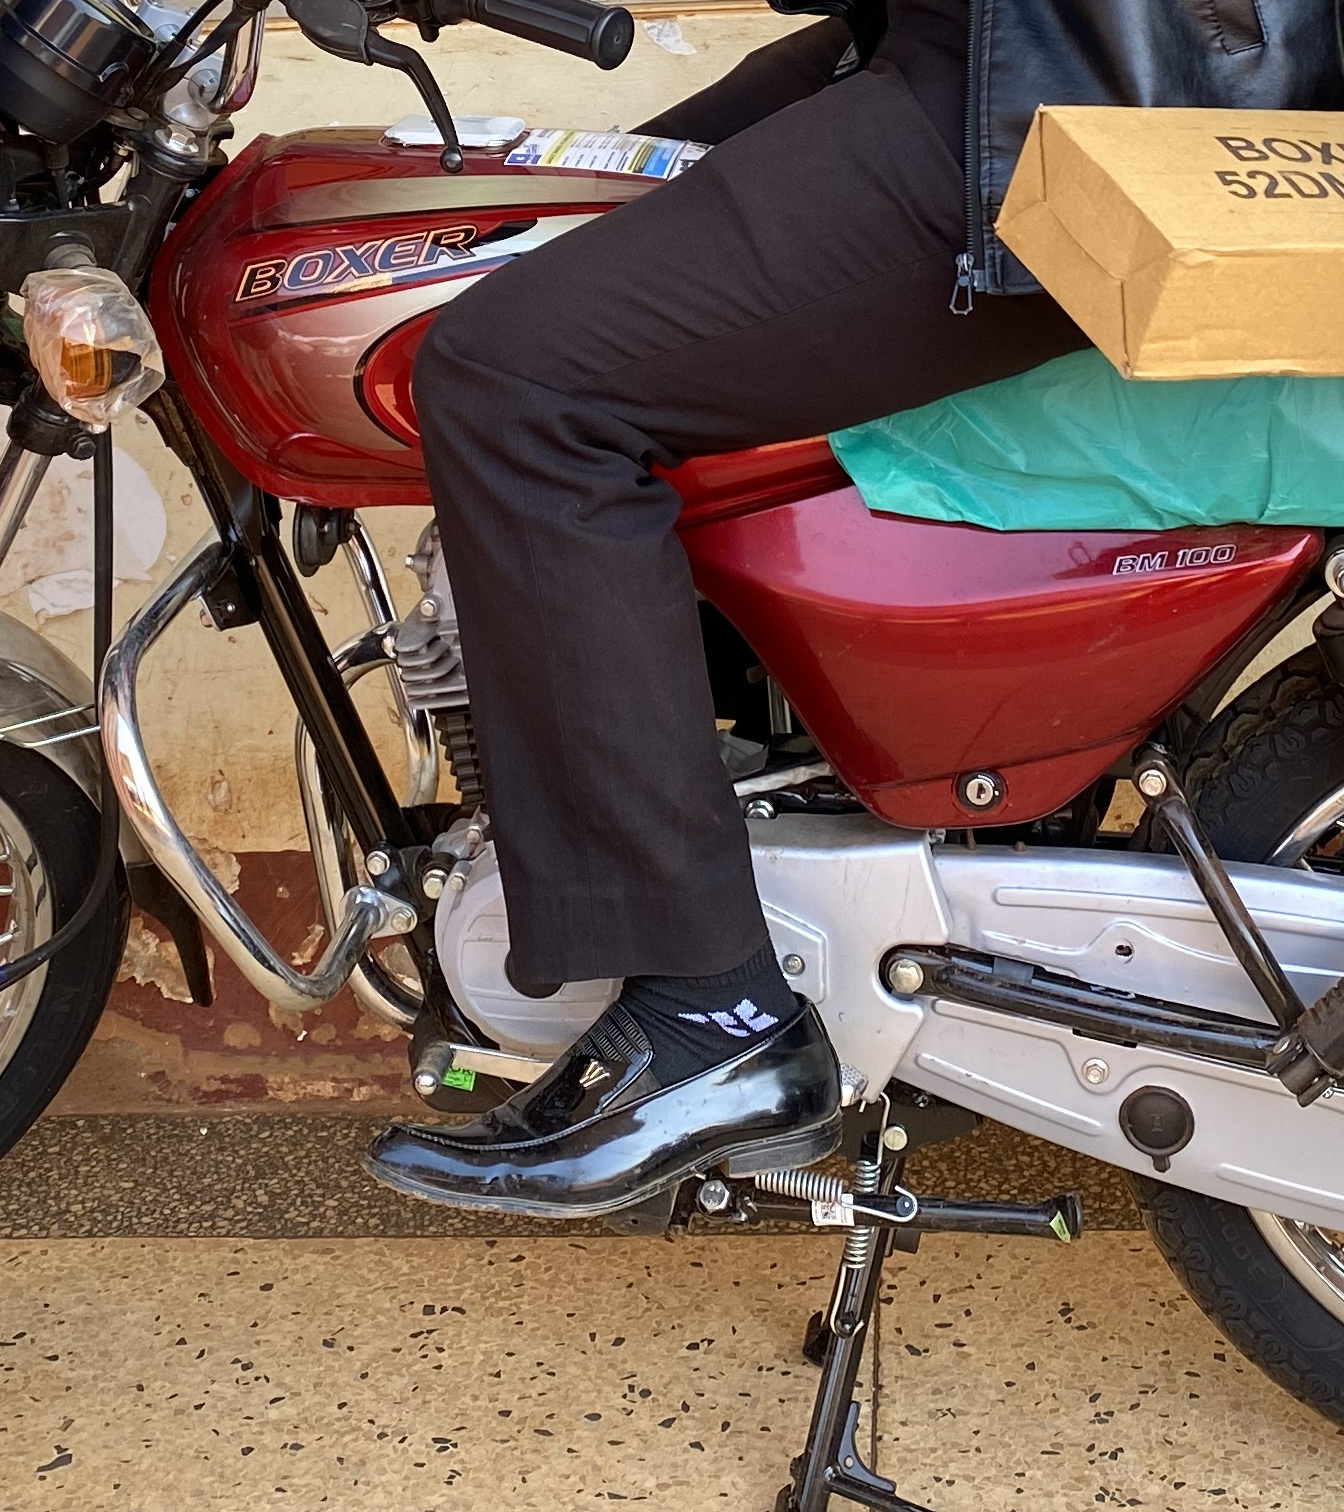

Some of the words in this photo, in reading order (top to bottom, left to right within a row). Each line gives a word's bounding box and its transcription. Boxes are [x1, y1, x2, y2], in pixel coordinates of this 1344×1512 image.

[234, 223, 479, 302] BOXER
[1112, 551, 1169, 576] BM
[1175, 544, 1237, 569] 100
